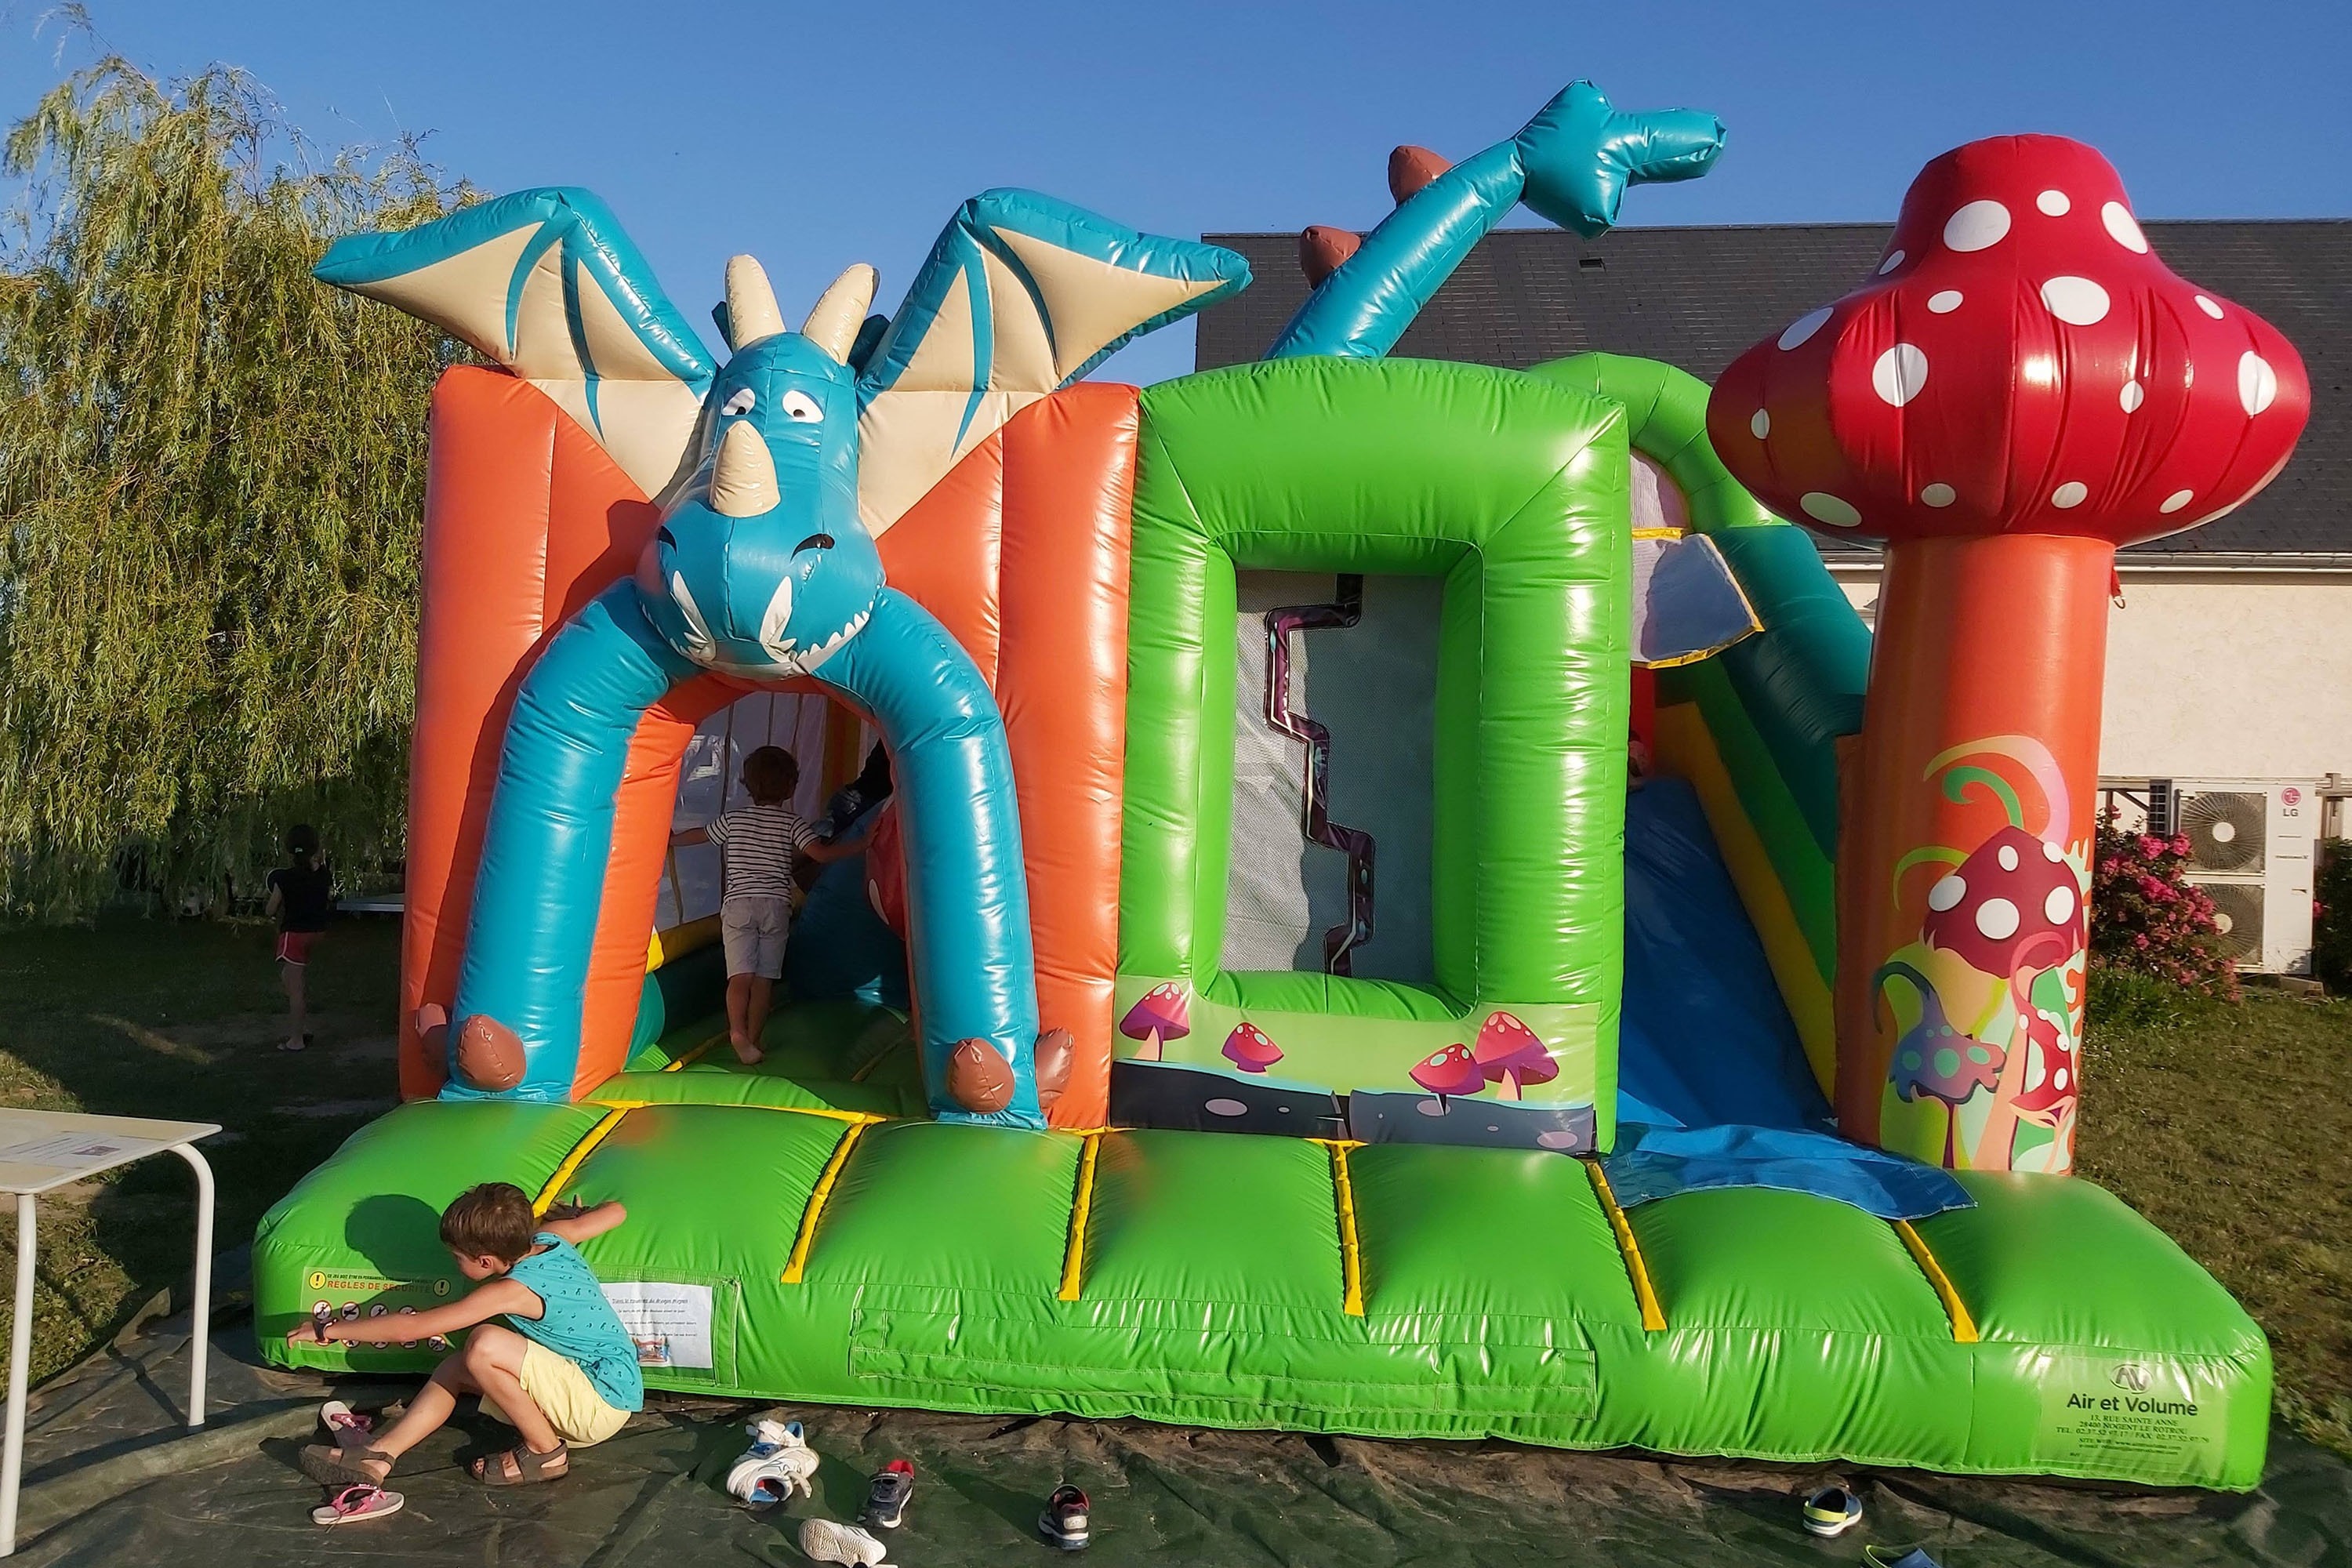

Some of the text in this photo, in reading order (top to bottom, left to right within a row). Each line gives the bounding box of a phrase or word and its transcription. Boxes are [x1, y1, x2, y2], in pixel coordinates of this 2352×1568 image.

[2282, 808, 2299, 817] LG
[2067, 1393, 2198, 1416] Air et Volume
[2122, 1415, 2153, 1425] SAINTE
[2156, 1417, 2180, 1426] ANNE
[2103, 1421, 2138, 1431] NOGENT
